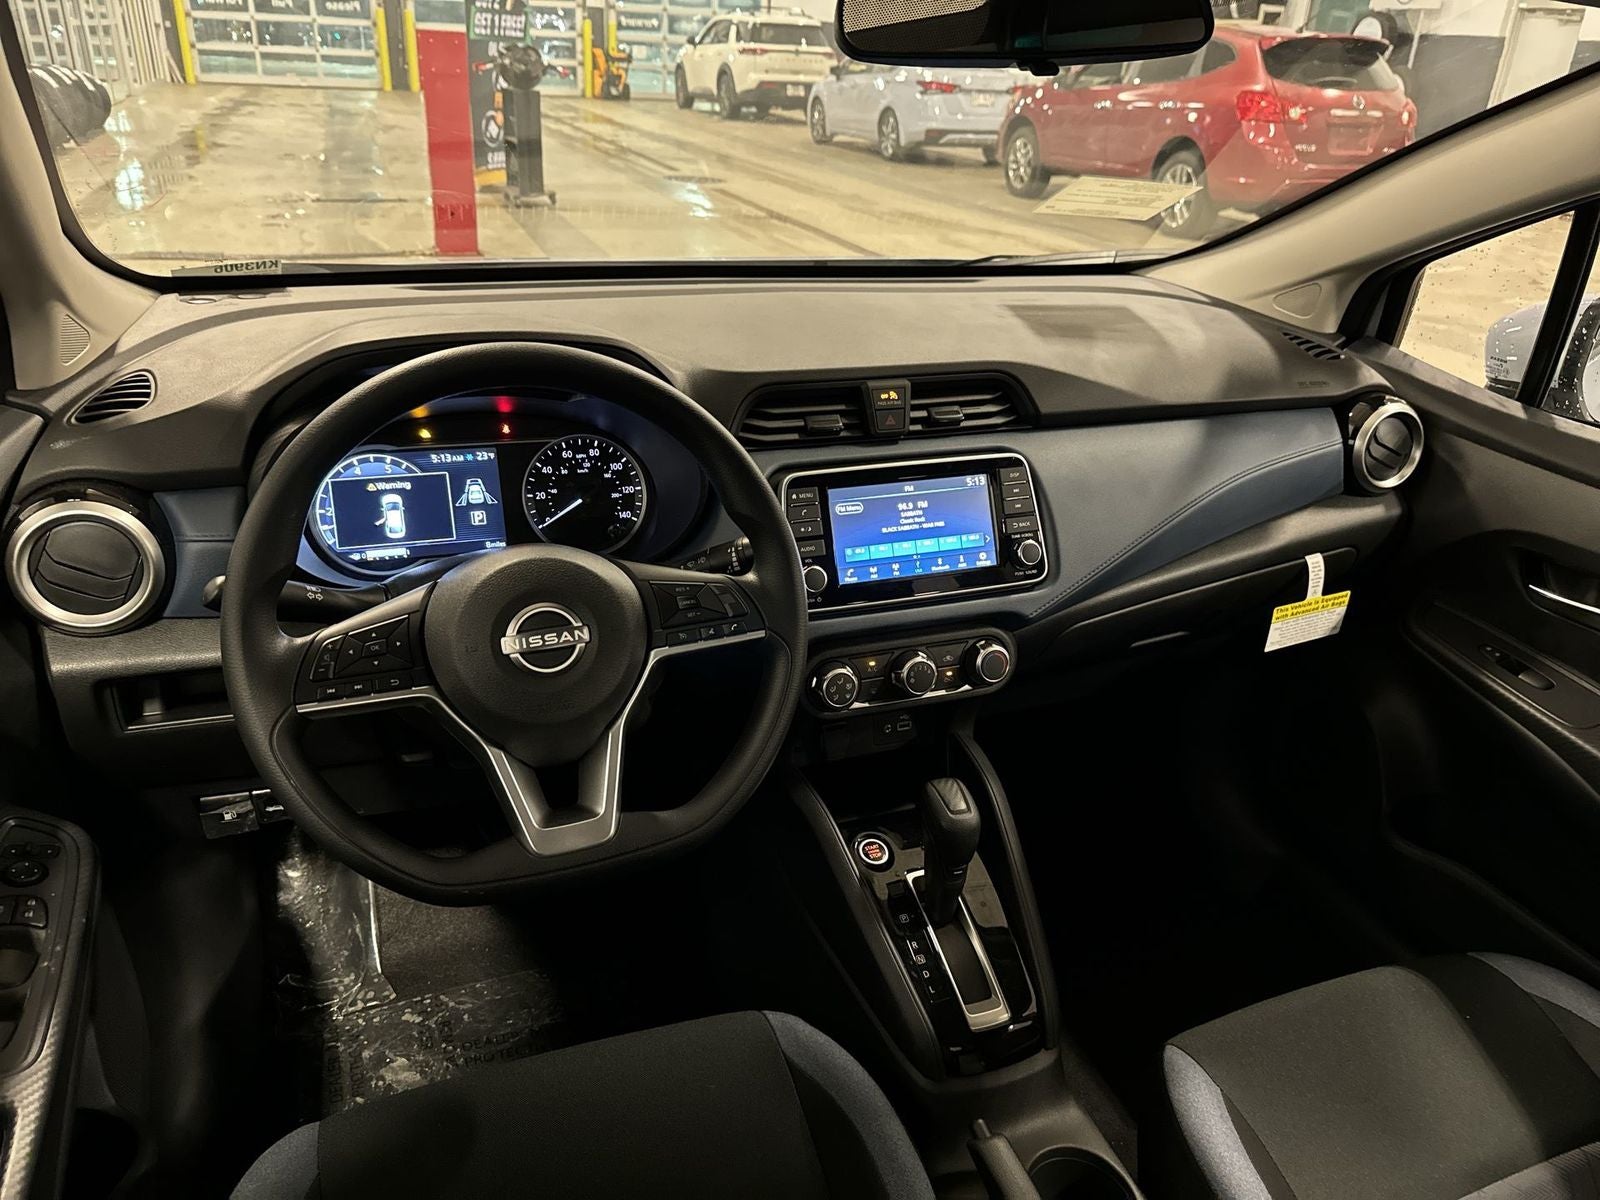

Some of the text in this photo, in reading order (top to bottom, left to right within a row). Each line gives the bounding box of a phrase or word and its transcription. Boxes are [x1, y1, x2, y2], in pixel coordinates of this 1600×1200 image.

[562, 450, 573, 458] 60
[588, 448, 600, 457] 80
[384, 465, 392, 473] 5
[541, 466, 553, 474] 40
[609, 462, 623, 471] 100
[354, 467, 361, 476] 4
[376, 481, 411, 490] Warning
[966, 477, 985, 486] 5:13
[622, 485, 635, 494] 120
[535, 492, 546, 500] 20
[846, 503, 862, 511] Menu
[917, 500, 928, 509] FM
[325, 508, 333, 516] 2
[474, 512, 483, 524] P
[1290, 601, 1313, 610] Vehicle
[1320, 593, 1349, 603] Equipped
[1289, 607, 1320, 616] Advanced
[506, 629, 588, 650] NISSAN
[911, 940, 919, 949] R
[922, 970, 930, 978] D
[928, 985, 936, 994] L
